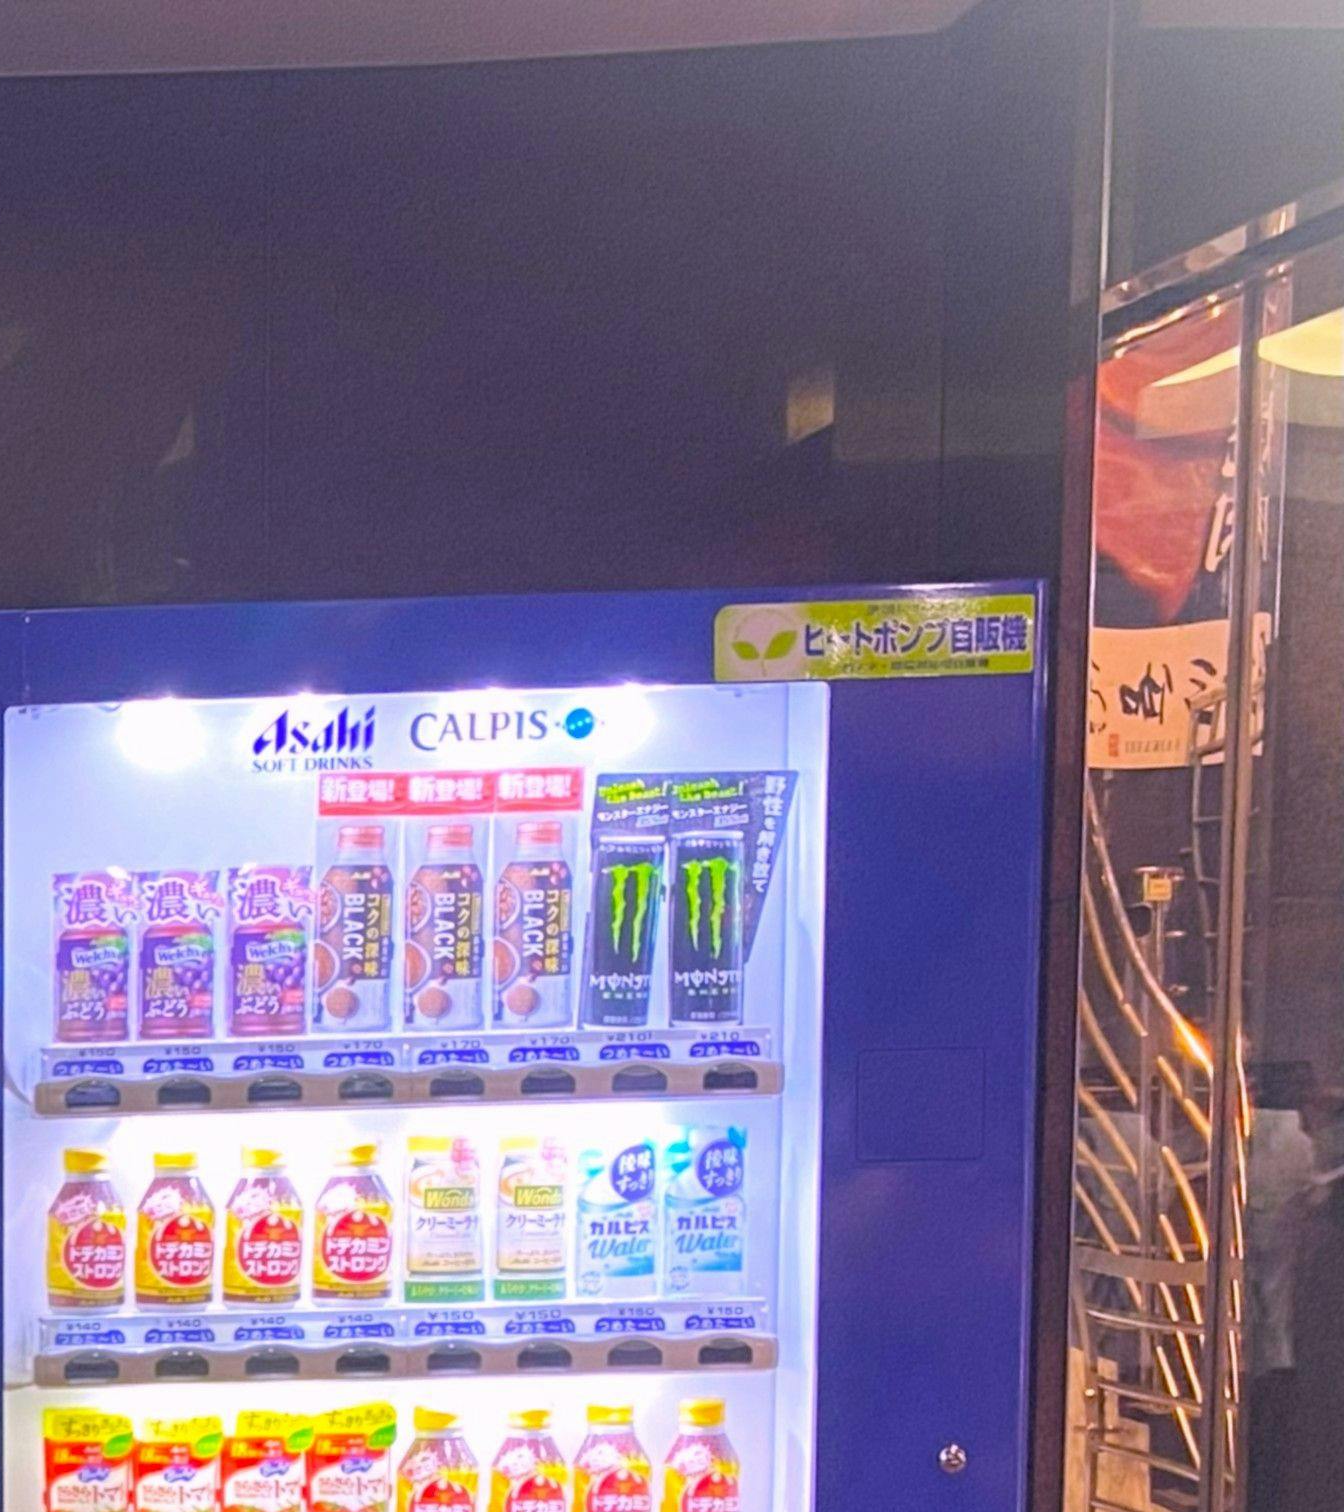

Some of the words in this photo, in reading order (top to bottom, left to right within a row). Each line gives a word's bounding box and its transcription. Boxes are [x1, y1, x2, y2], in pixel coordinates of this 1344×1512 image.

[252, 705, 376, 755] Asahi
[410, 710, 549, 752] CALPIS
[251, 759, 298, 773] SOFT
[304, 756, 373, 772] DRINKS
[62, 883, 137, 925] 濃い
[146, 882, 221, 924] 濃い
[237, 880, 312, 922] 濃い
[343, 893, 365, 960] BLACK
[434, 892, 456, 961] BLACK
[523, 889, 544, 957] BLACK
